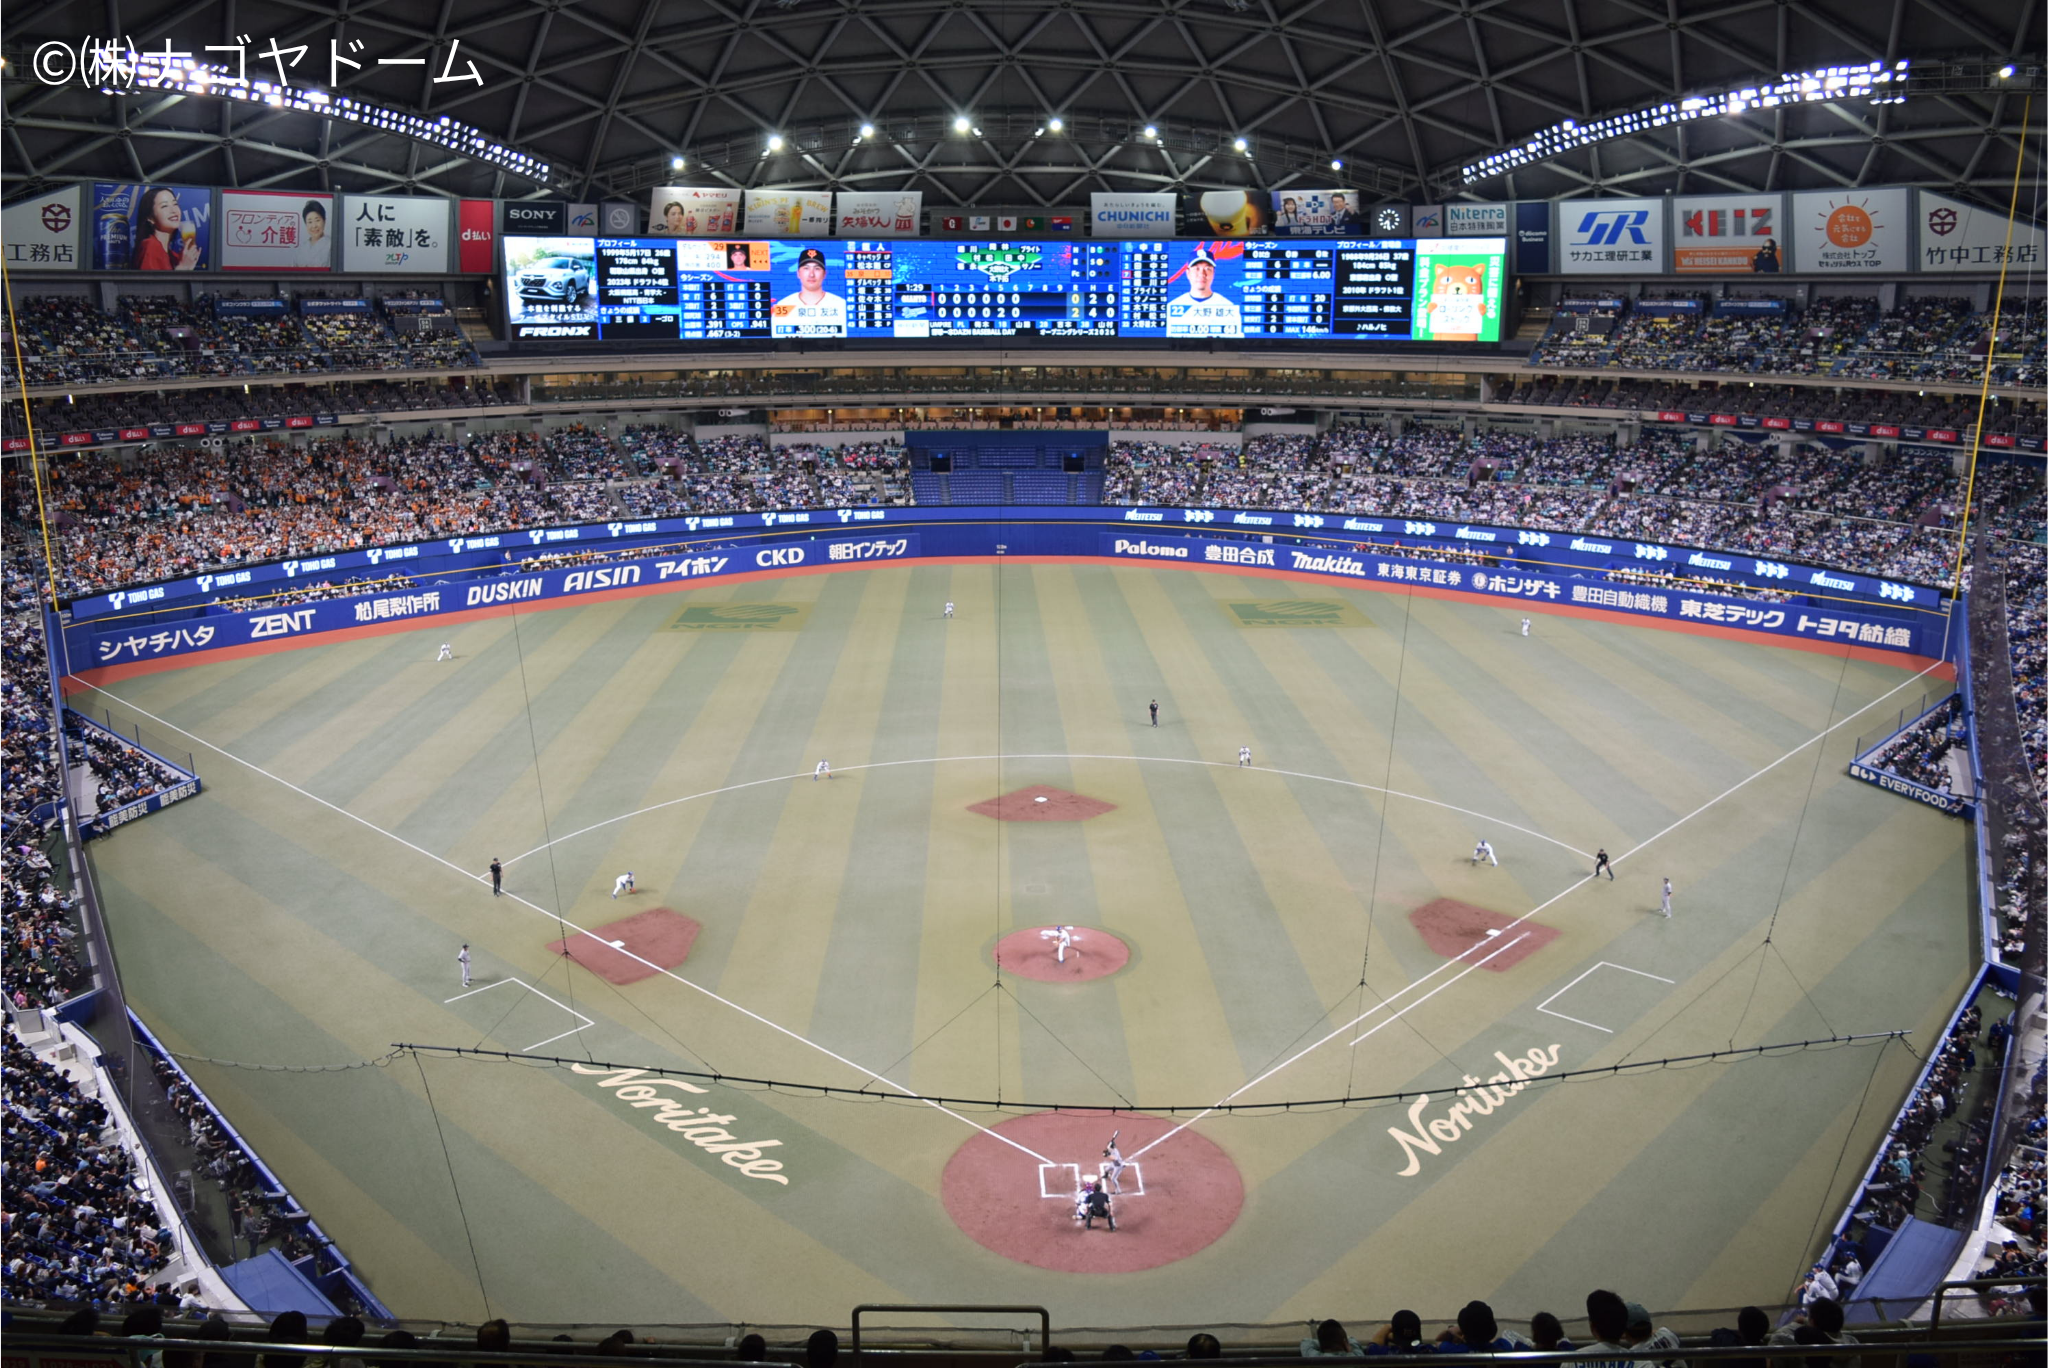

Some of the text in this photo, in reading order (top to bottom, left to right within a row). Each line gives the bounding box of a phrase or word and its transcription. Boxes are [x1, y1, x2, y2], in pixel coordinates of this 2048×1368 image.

[356, 202, 396, 223] 人に
[509, 209, 557, 220] SONY
[806, 200, 829, 213] BREW
[1450, 207, 1505, 220] Niterra
[1097, 211, 1170, 223] CHUNICHI
[1683, 207, 1773, 237] KEIZ
[261, 225, 297, 245] 介護
[356, 227, 438, 249] 「素敵」を。
[462, 228, 491, 242] d払い
[1289, 225, 1346, 235] 東海テレビ
[714, 242, 724, 251] 29
[1842, 234, 1859, 243] 会社
[1, 243, 73, 263] 工務店
[615, 257, 638, 265] 178cm
[1005, 254, 1025, 262] 田中
[1822, 250, 1876, 259] 株式会社 トップ
[1925, 244, 2038, 265] 竹中工務店
[1313, 271, 1331, 279] 6.00
[905, 284, 925, 292] 1:29
[938, 294, 1115, 304] 0 0 0 0 0 0 0 2 0
[1315, 294, 1326, 302] 20
[776, 306, 788, 315] 35
[938, 307, 1115, 318] 0 0 0 0 2 0 2 4 0
[1171, 306, 1184, 315] 22
[1194, 308, 1212, 317] 大野
[519, 326, 592, 337] FRONX
[1189, 325, 1209, 333] 0.00
[701, 517, 734, 528] TOHO GAS
[778, 513, 810, 523] TOHO GAS
[854, 510, 885, 520] TOHO GAS
[1125, 509, 1163, 522] MEITETSU
[1233, 512, 1273, 526] MEITETSU
[624, 522, 656, 533] TOHO GAS
[1343, 517, 1384, 533] MEITETSU
[546, 528, 579, 540] TOHO GAS
[1455, 525, 1496, 542] MEITETSU
[466, 537, 499, 549] TOHO GAS
[829, 539, 907, 561] 朝日インテック
[1114, 539, 1188, 558] Paloma
[1570, 536, 1612, 554] MEITETSU
[384, 546, 419, 560] TOHO GAS
[755, 547, 805, 567] CKD
[1204, 545, 1275, 566] 豊田合成
[301, 558, 336, 572] TOHO GAS
[655, 556, 729, 580] アイホン
[1291, 551, 1366, 577] Makita
[1688, 552, 1731, 571] MEITETSU
[216, 571, 251, 587] TOHO GAS
[563, 565, 641, 592] AISIN
[1377, 562, 1462, 586] 東海東京証券
[1811, 570, 1855, 592] MEITETSU
[127, 587, 165, 603] TOHO GAS
[467, 577, 543, 605] DUSKIN
[1487, 575, 1561, 600] ホシザキ
[354, 591, 440, 622] 松尾製作所
[1571, 585, 1667, 614] 豊田自動織機
[1679, 599, 1786, 629] 東芝テック
[249, 609, 317, 639] ZENT
[1797, 614, 1911, 649] トヨタ紡織
[99, 625, 215, 661] シヤチハタ
[159, 781, 198, 808] 能美防災
[1879, 775, 1949, 809] EVERYFOOD
[107, 801, 149, 829] 能美防災
[1387, 1043, 1562, 1177] Noritake
[570, 1062, 790, 1187] Noritake
